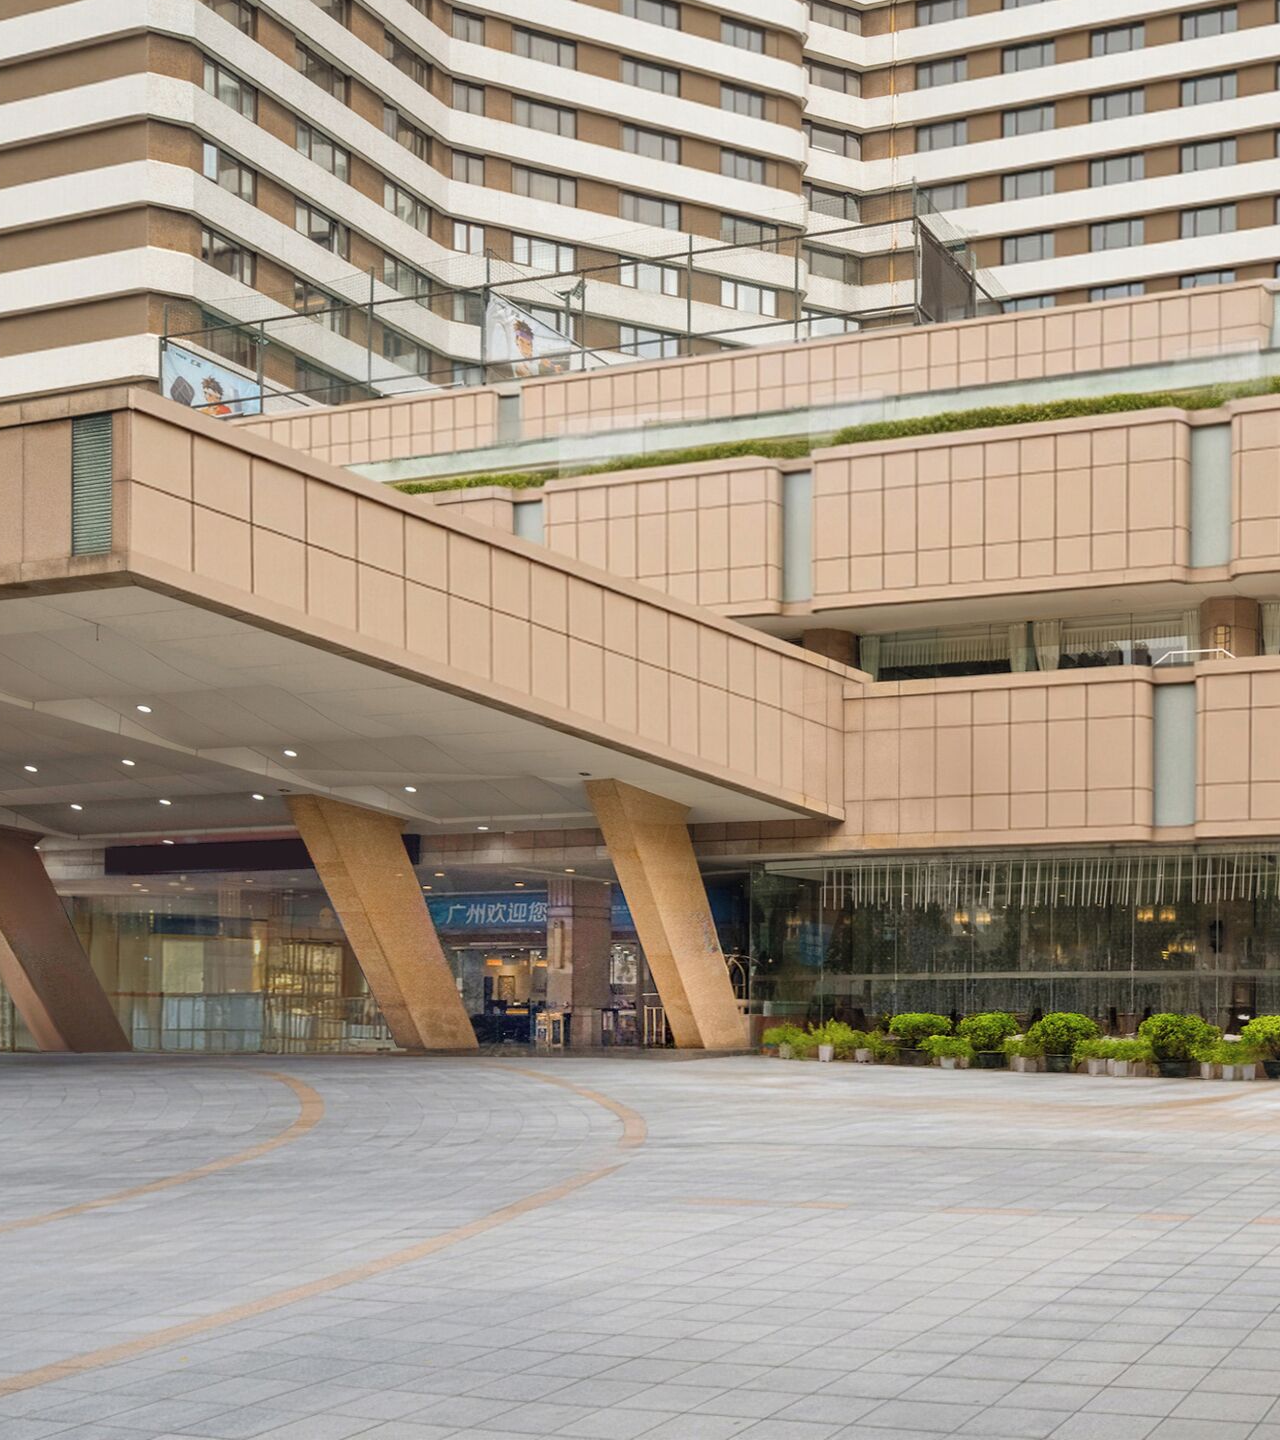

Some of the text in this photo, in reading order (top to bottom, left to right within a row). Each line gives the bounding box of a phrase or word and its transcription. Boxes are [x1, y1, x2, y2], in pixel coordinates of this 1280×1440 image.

[445, 901, 548, 924] 广州欢迎您
